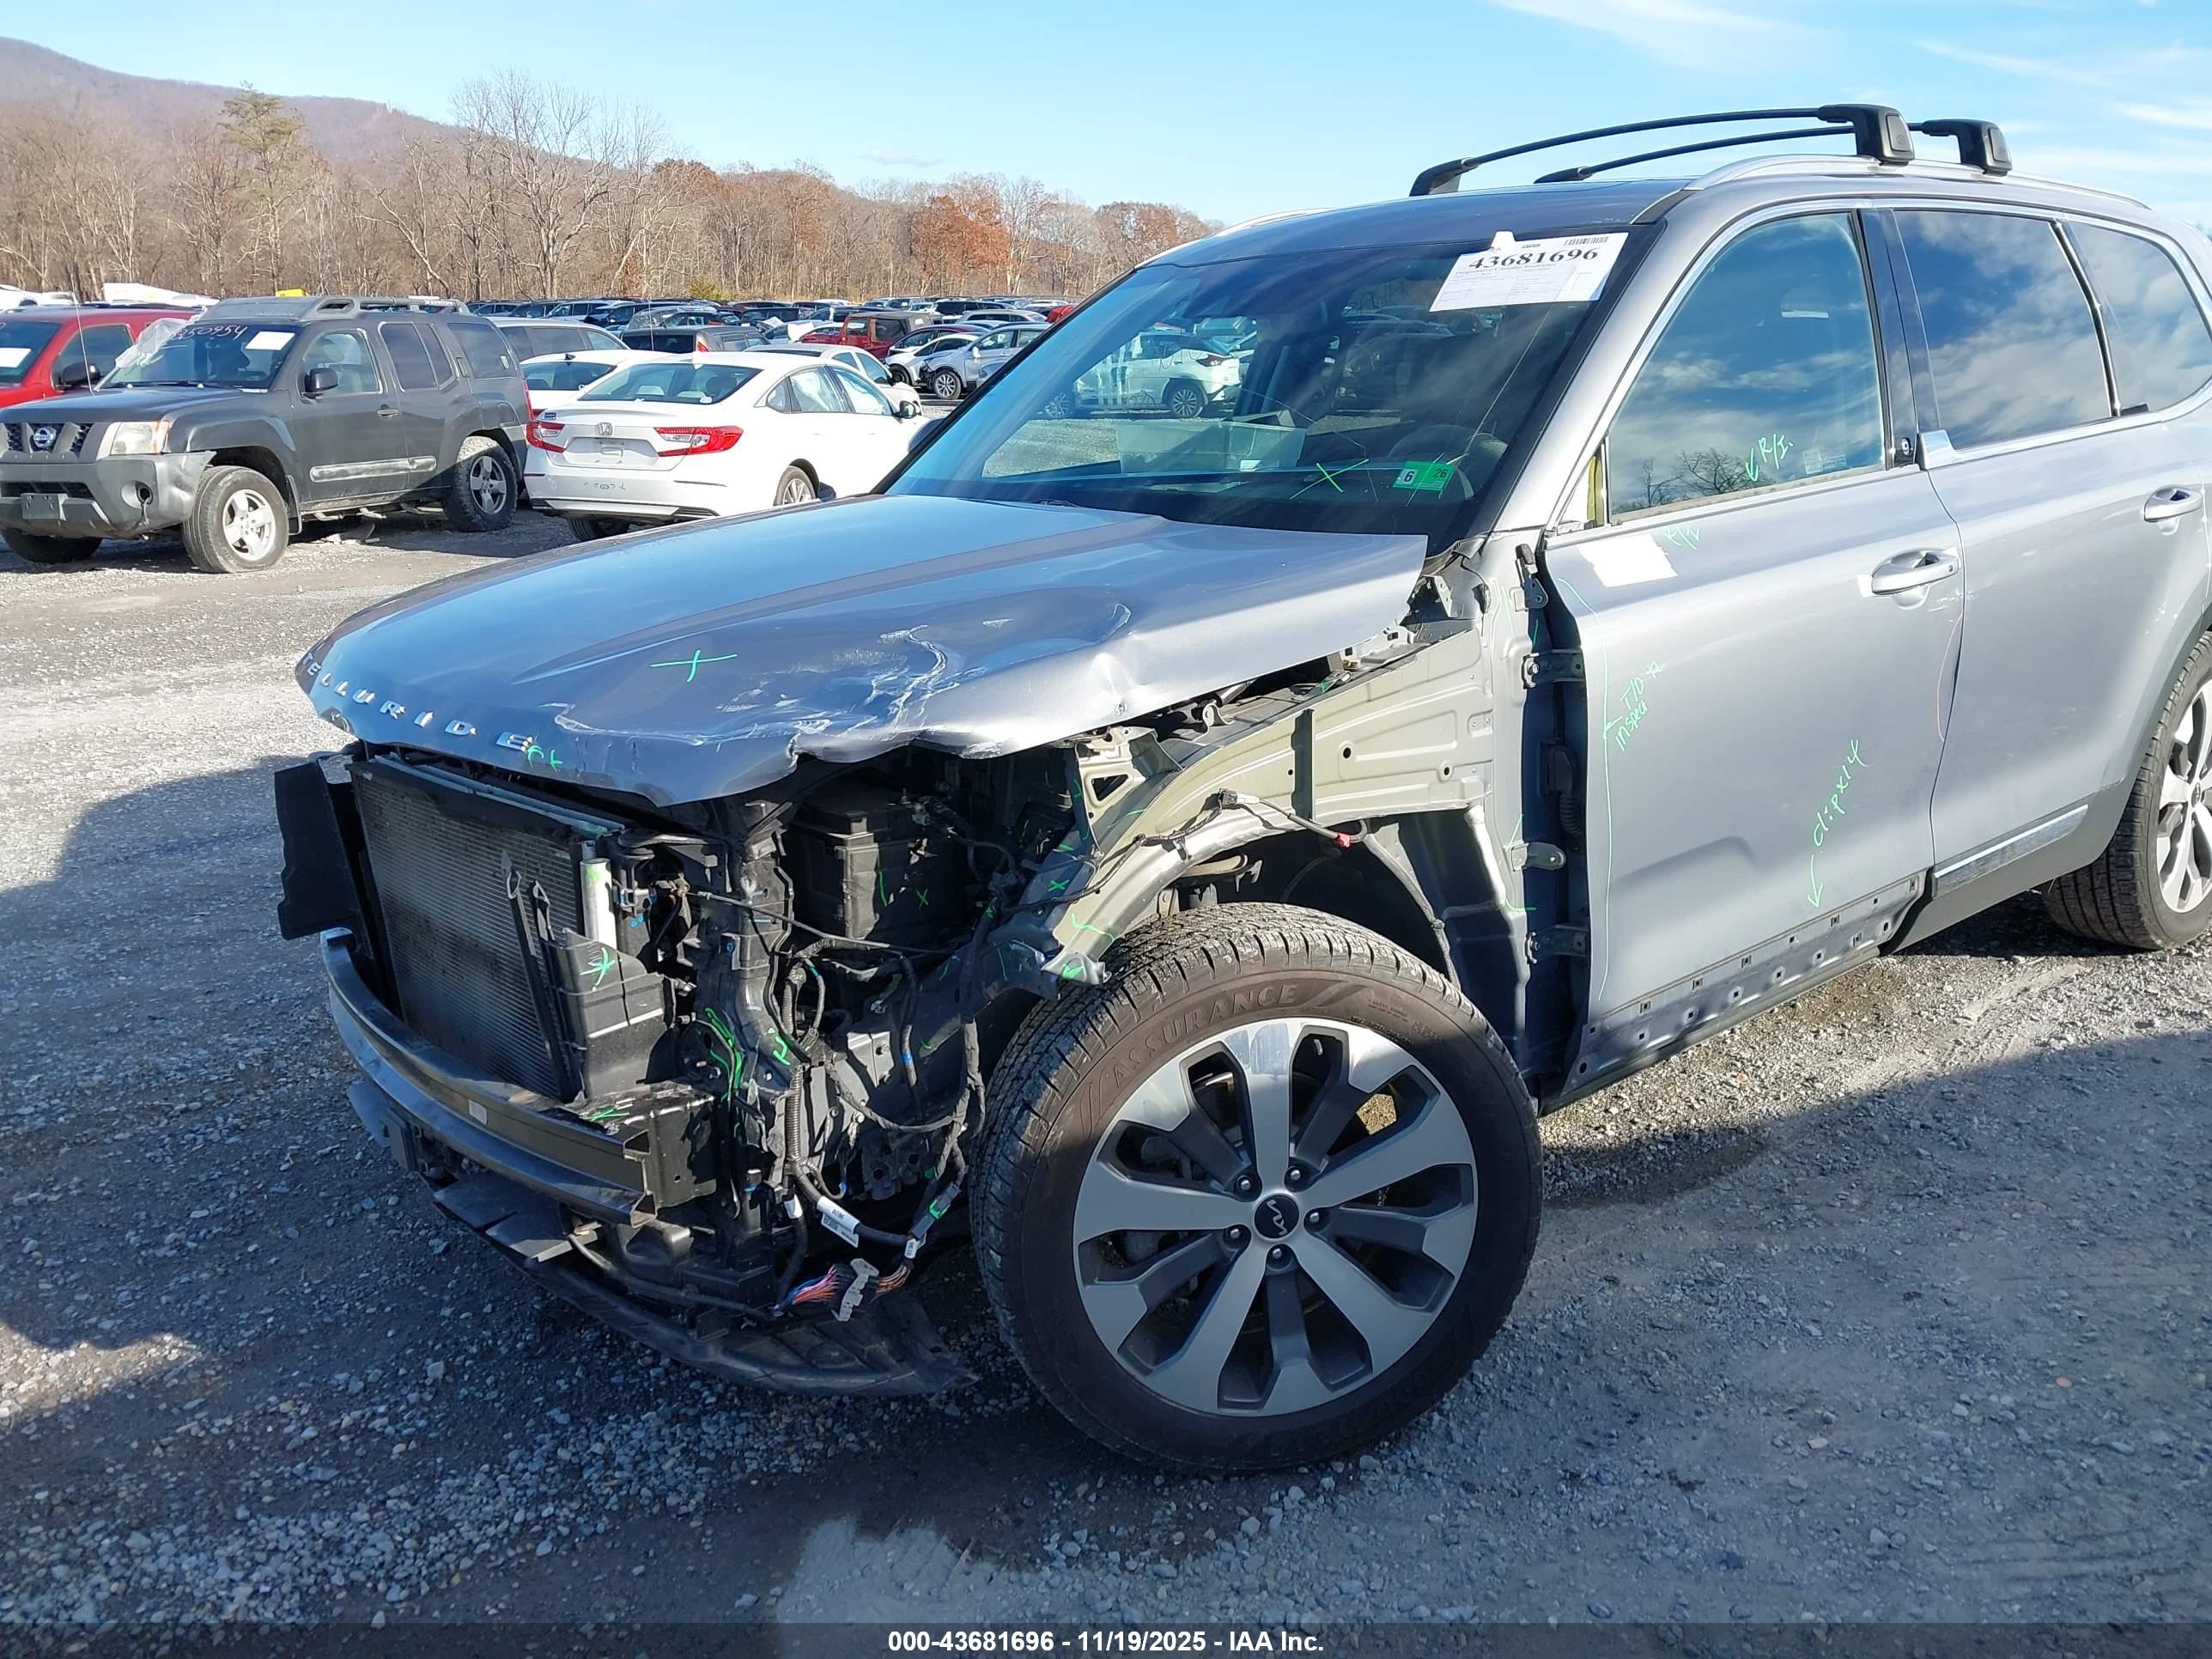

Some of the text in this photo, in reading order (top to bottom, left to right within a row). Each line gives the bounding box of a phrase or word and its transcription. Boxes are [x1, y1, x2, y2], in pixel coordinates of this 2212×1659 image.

[1469, 247, 1599, 269] 43681696
[1405, 469, 1449, 483] 6 26
[302, 653, 535, 753] TELLURIDE
[1112, 983, 1299, 1088] ASSURANCE
